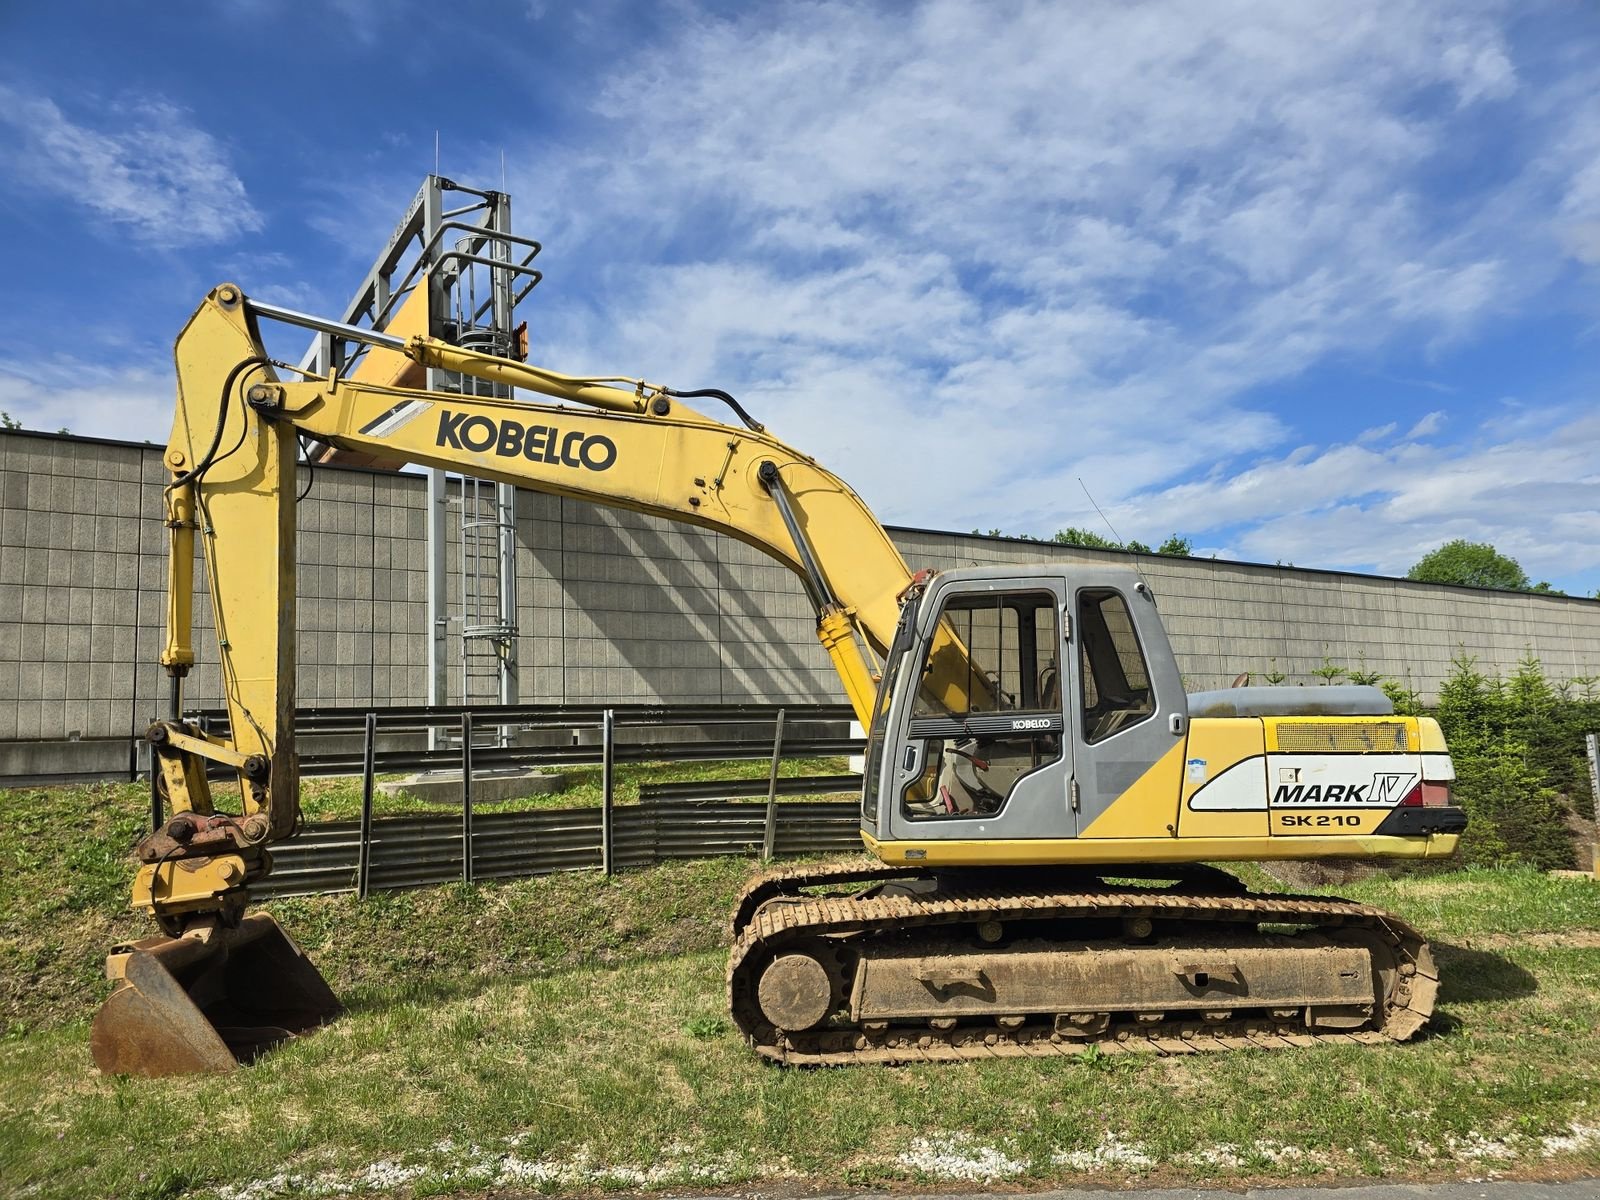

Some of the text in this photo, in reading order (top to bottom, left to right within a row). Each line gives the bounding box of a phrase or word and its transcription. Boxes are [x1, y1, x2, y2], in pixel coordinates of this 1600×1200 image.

[436, 410, 617, 471] KOBELCO
[1012, 719, 1051, 730] KOBELCO
[1273, 773, 1417, 803] MARK IV
